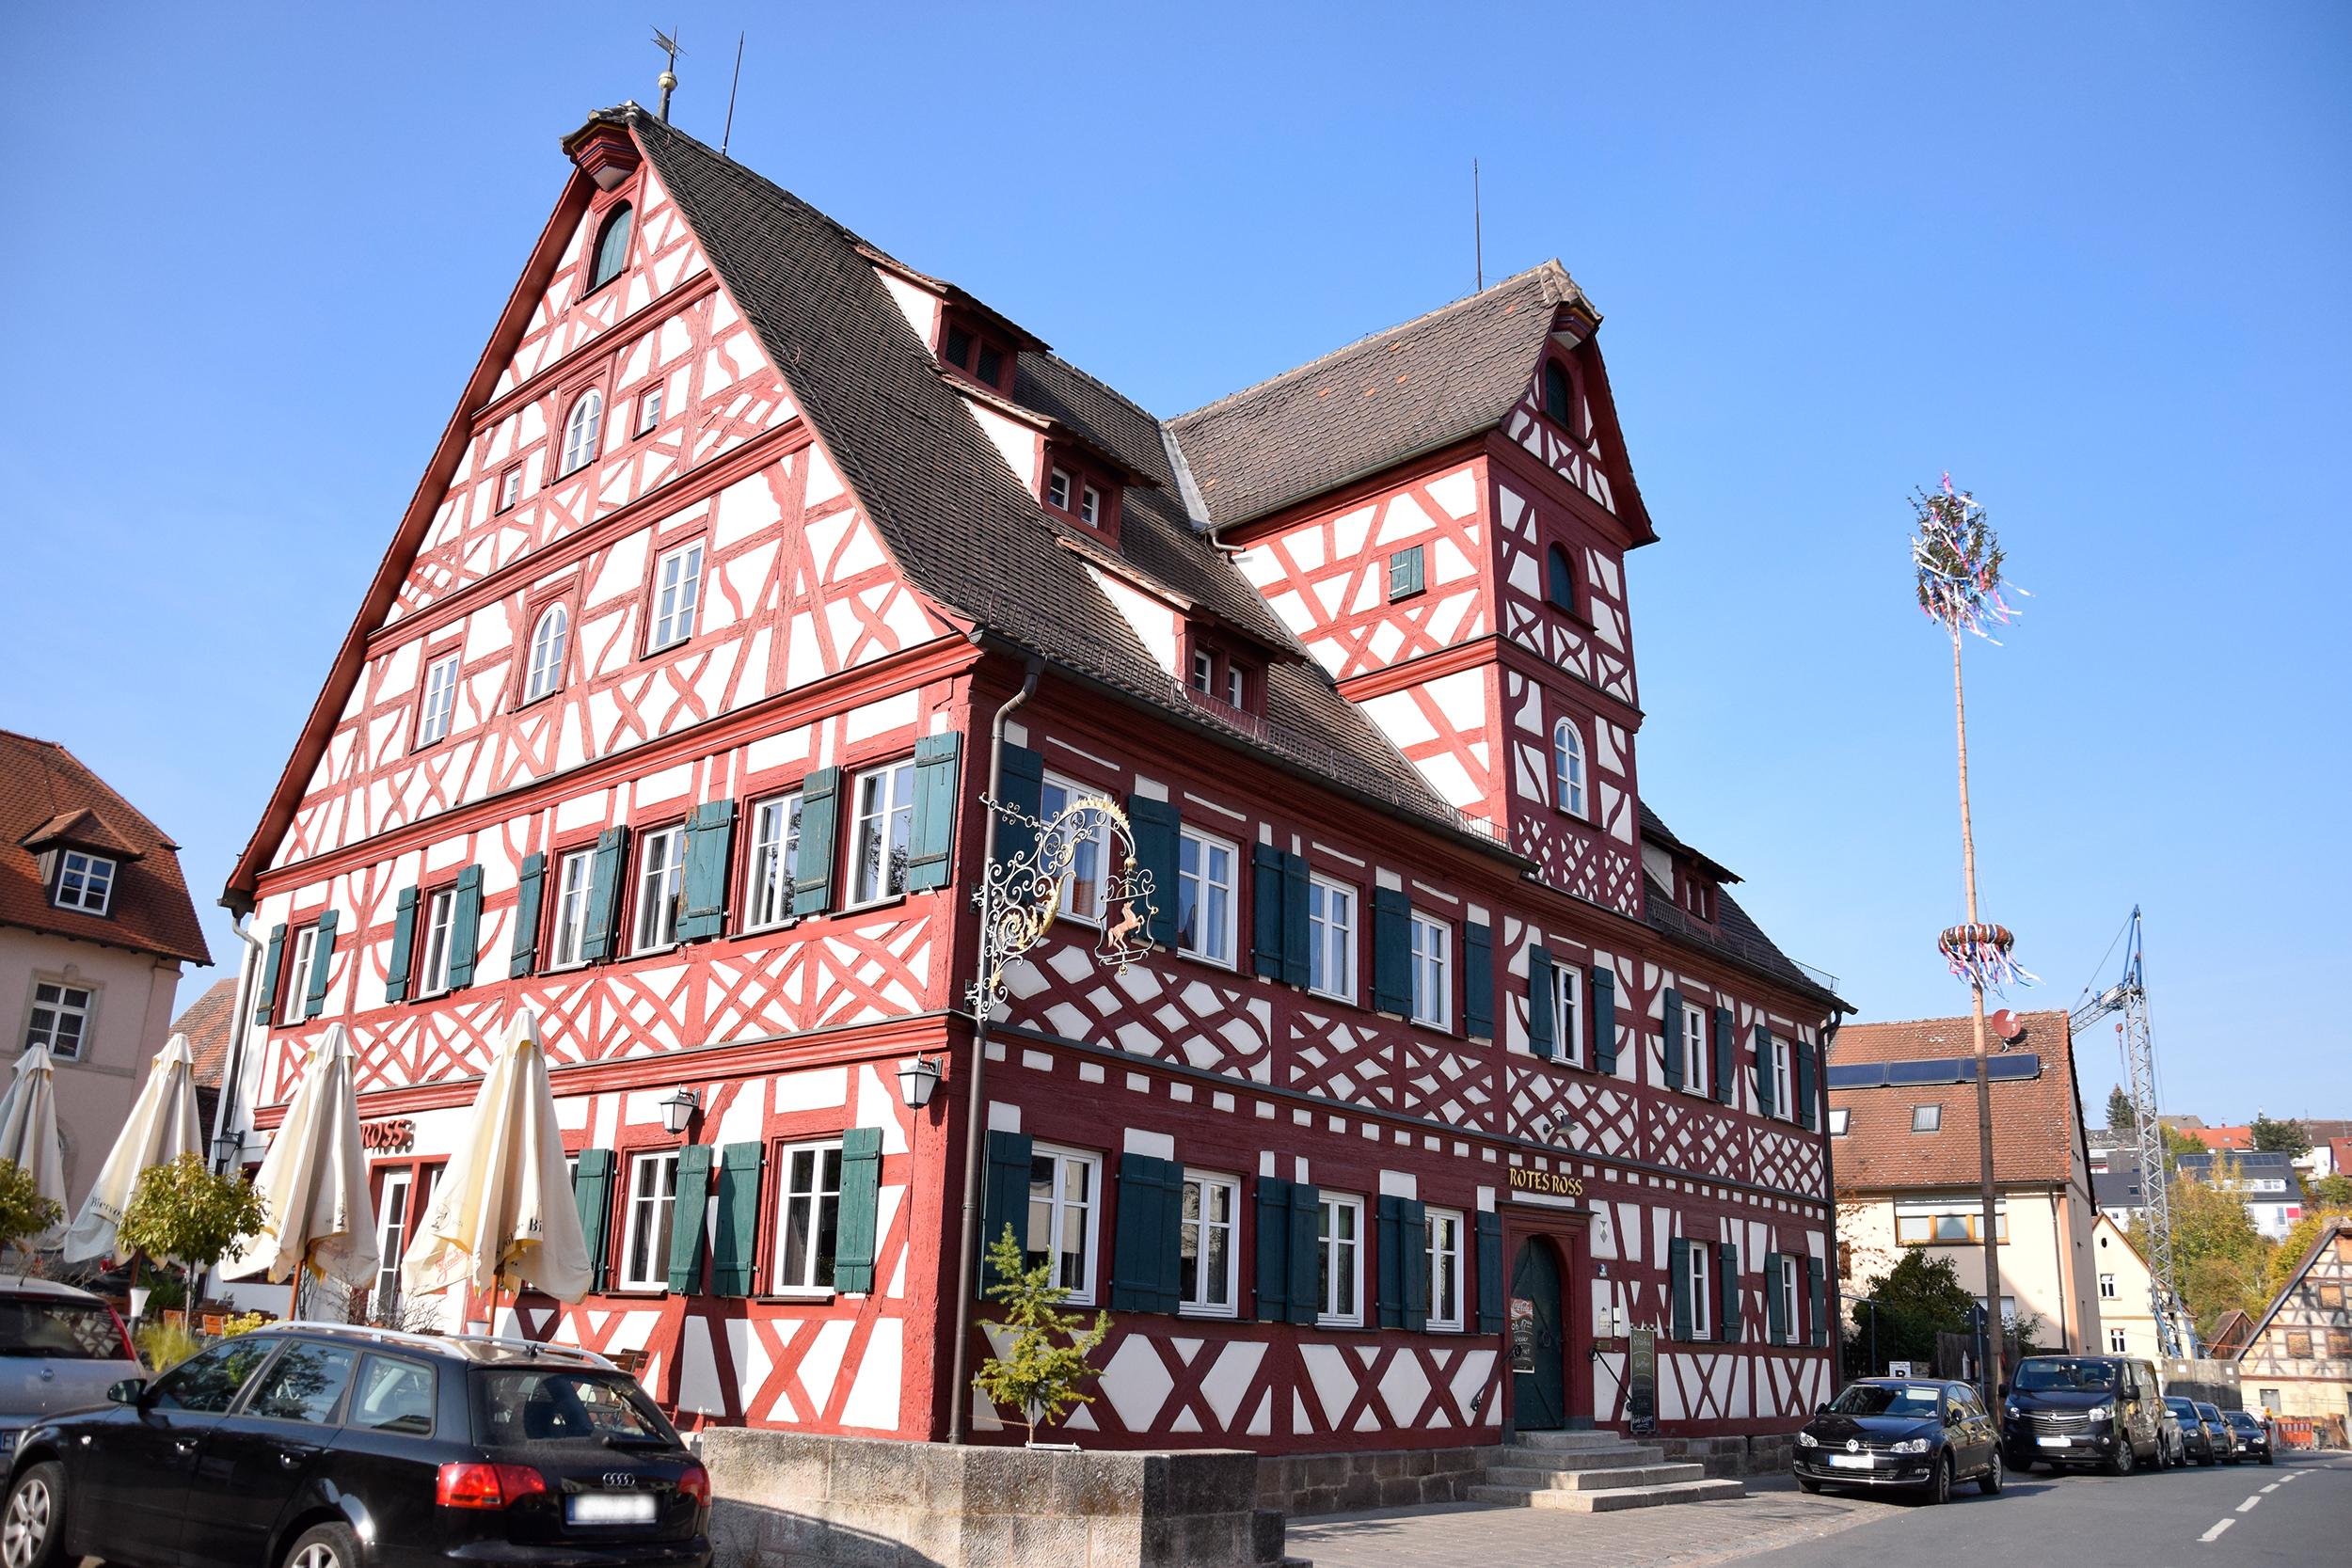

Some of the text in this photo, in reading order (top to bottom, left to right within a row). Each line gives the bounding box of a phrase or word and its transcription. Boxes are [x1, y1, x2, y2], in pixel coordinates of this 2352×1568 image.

[360, 1119, 411, 1148] ROSS
[1509, 1167, 1583, 1196] ROTES ROSS
